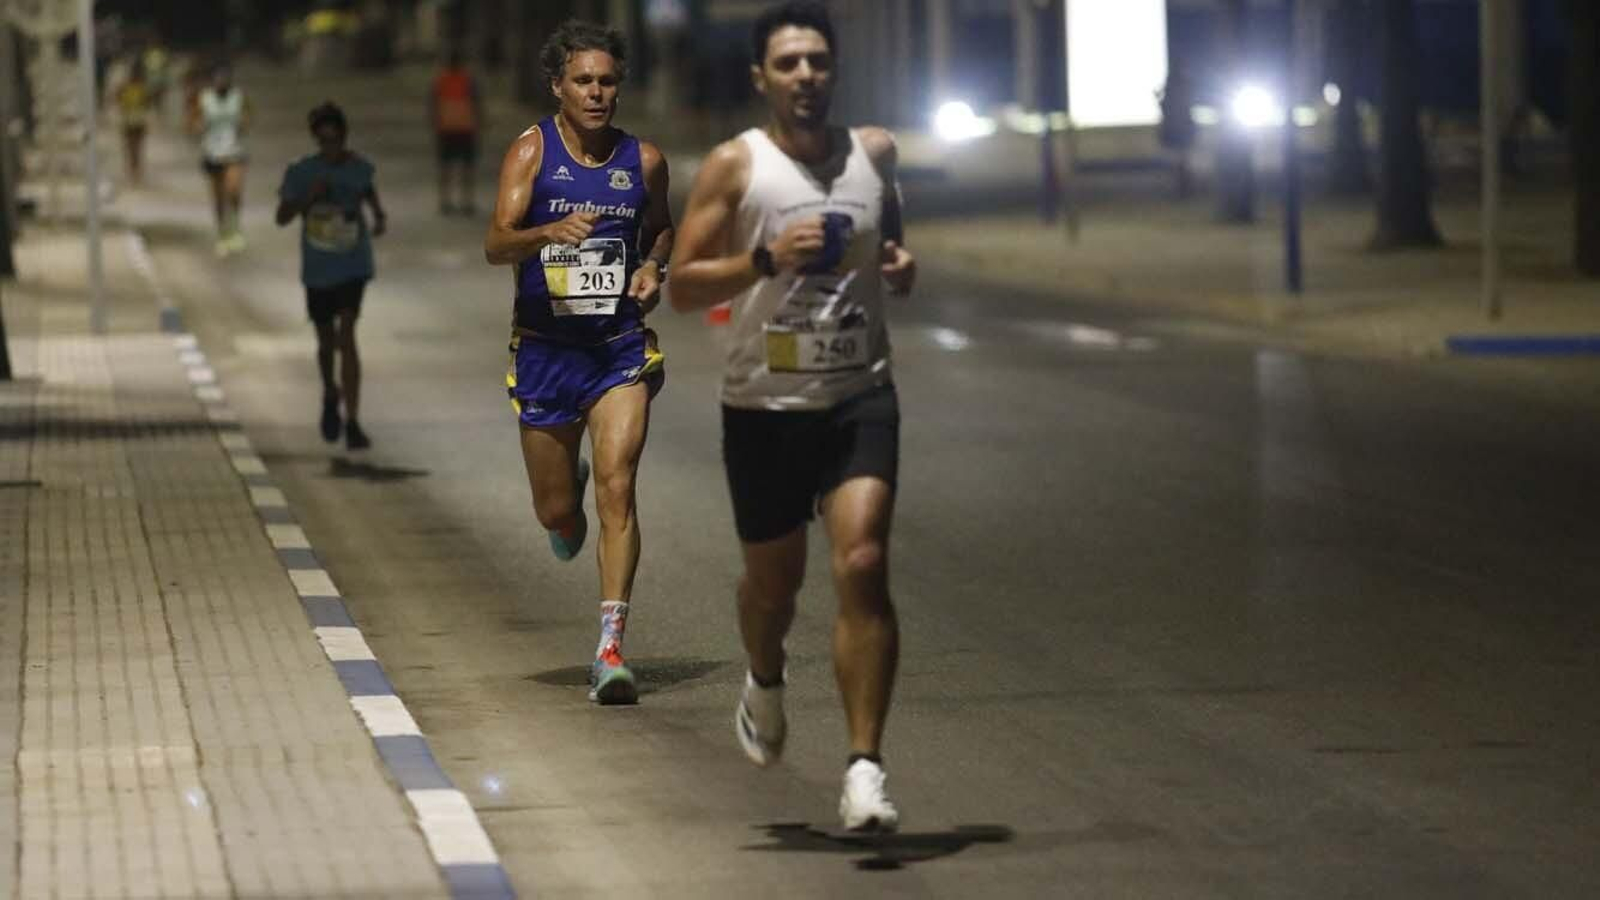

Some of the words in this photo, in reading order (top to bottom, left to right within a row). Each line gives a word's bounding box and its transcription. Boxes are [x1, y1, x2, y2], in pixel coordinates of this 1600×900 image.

[548, 198, 636, 218] Tirabuzón
[580, 272, 615, 290] 203
[813, 338, 856, 364] 250
